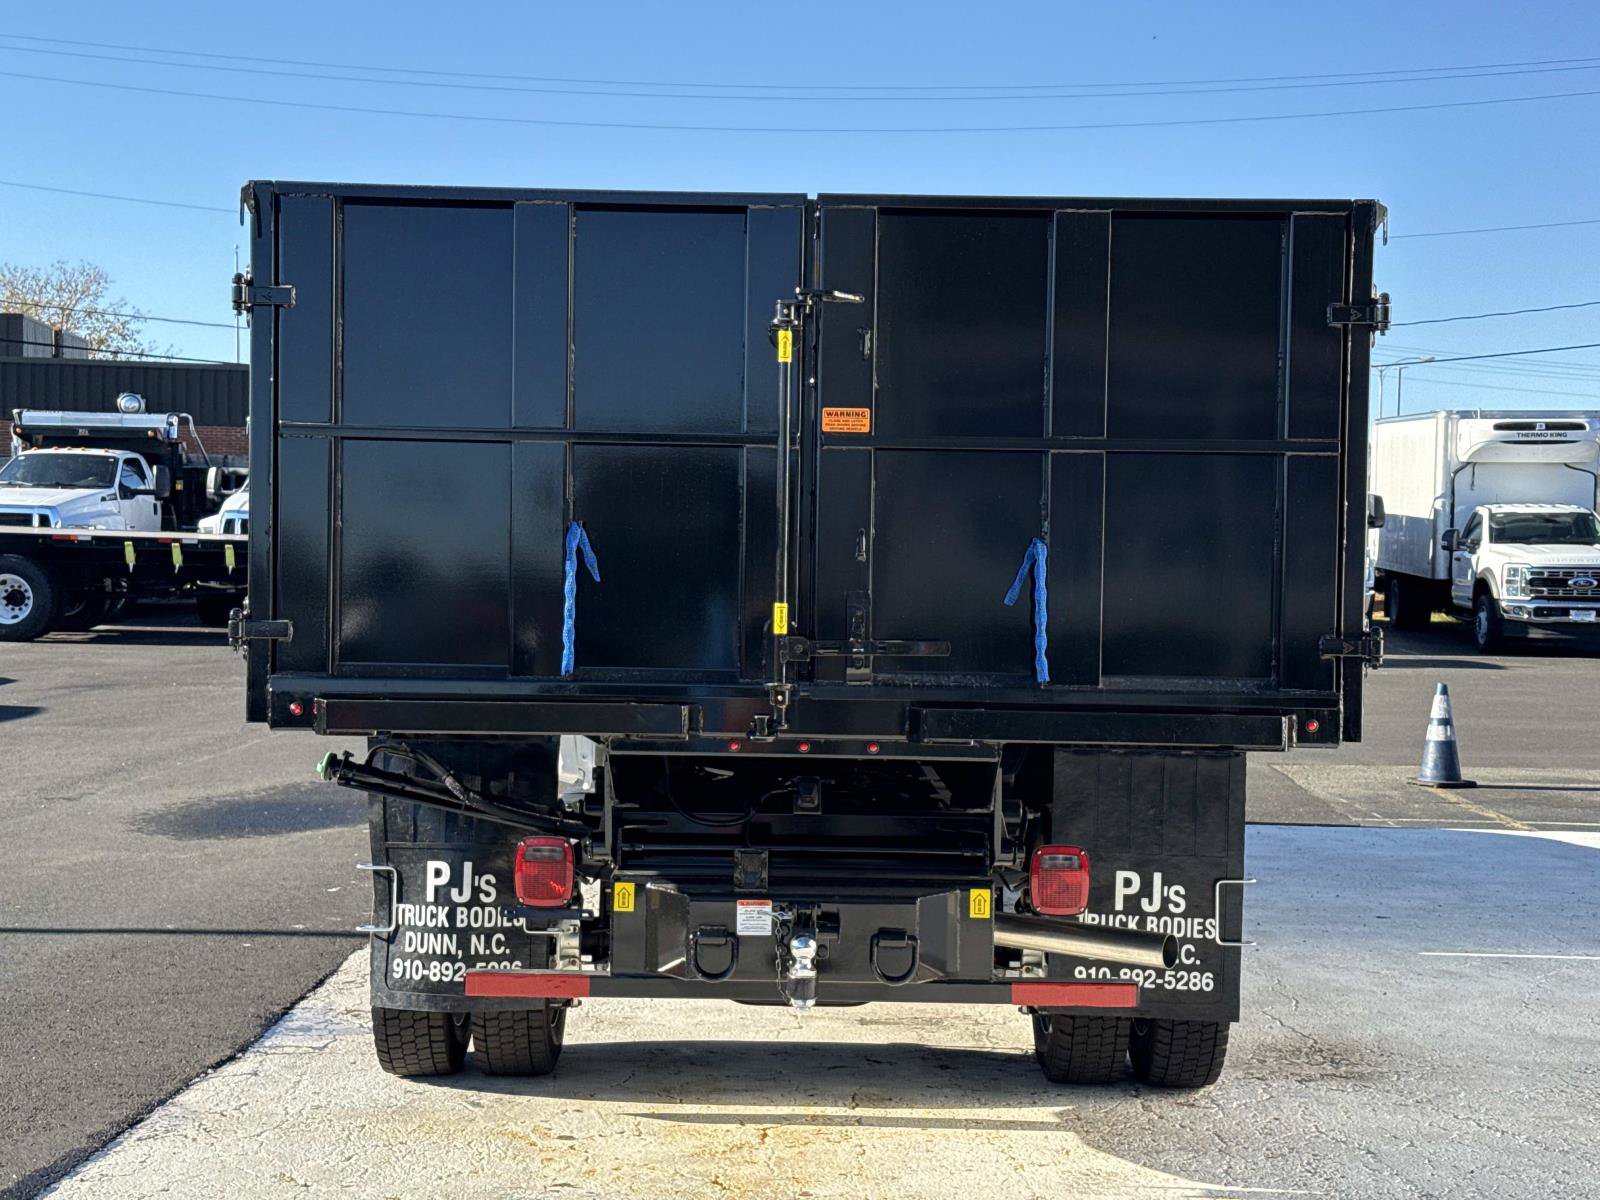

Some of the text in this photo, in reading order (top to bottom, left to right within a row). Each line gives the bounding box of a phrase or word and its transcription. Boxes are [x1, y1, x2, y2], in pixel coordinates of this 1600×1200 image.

[396, 904, 450, 928] TRUCK
[1146, 916, 1216, 939] BODIES
[404, 931, 511, 959] DUNN, N.C.
